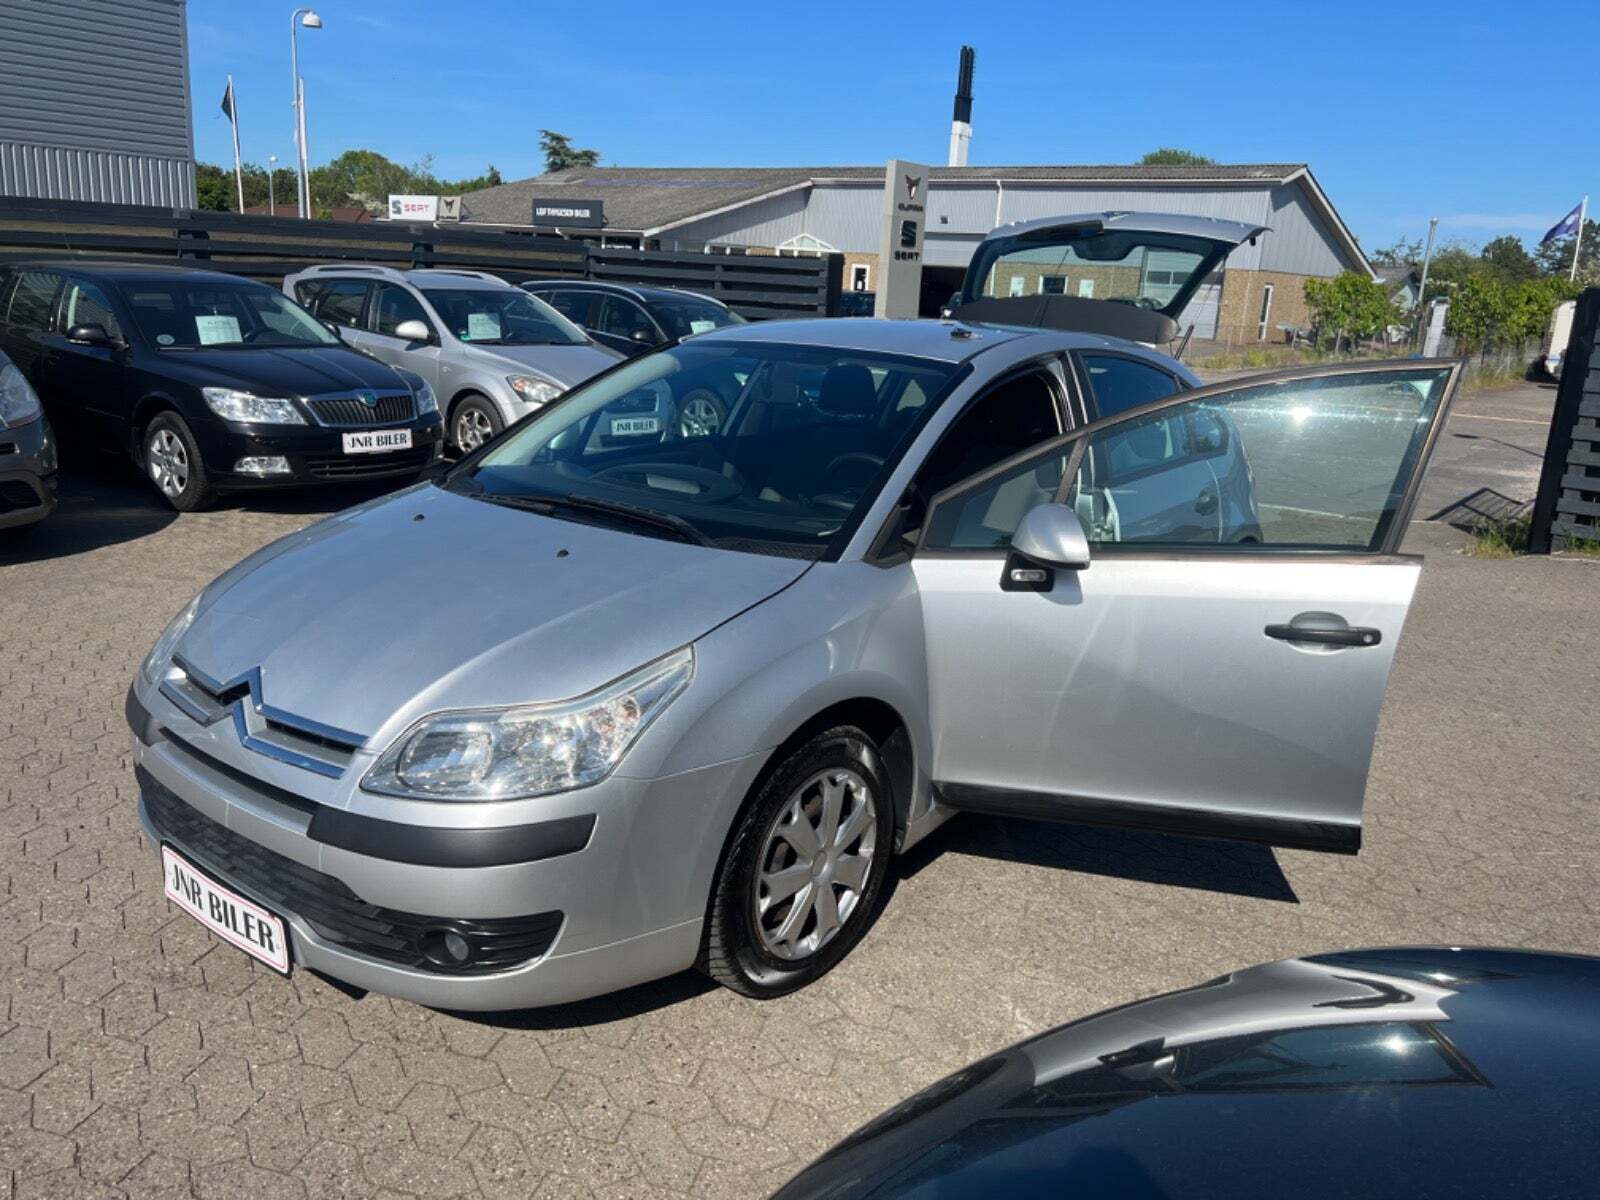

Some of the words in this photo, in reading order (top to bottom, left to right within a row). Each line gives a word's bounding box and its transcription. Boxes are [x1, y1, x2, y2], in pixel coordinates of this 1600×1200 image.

[348, 436, 372, 448] JNR
[376, 433, 407, 447] BILER
[172, 863, 203, 911] JNR
[207, 890, 275, 954] BILER
